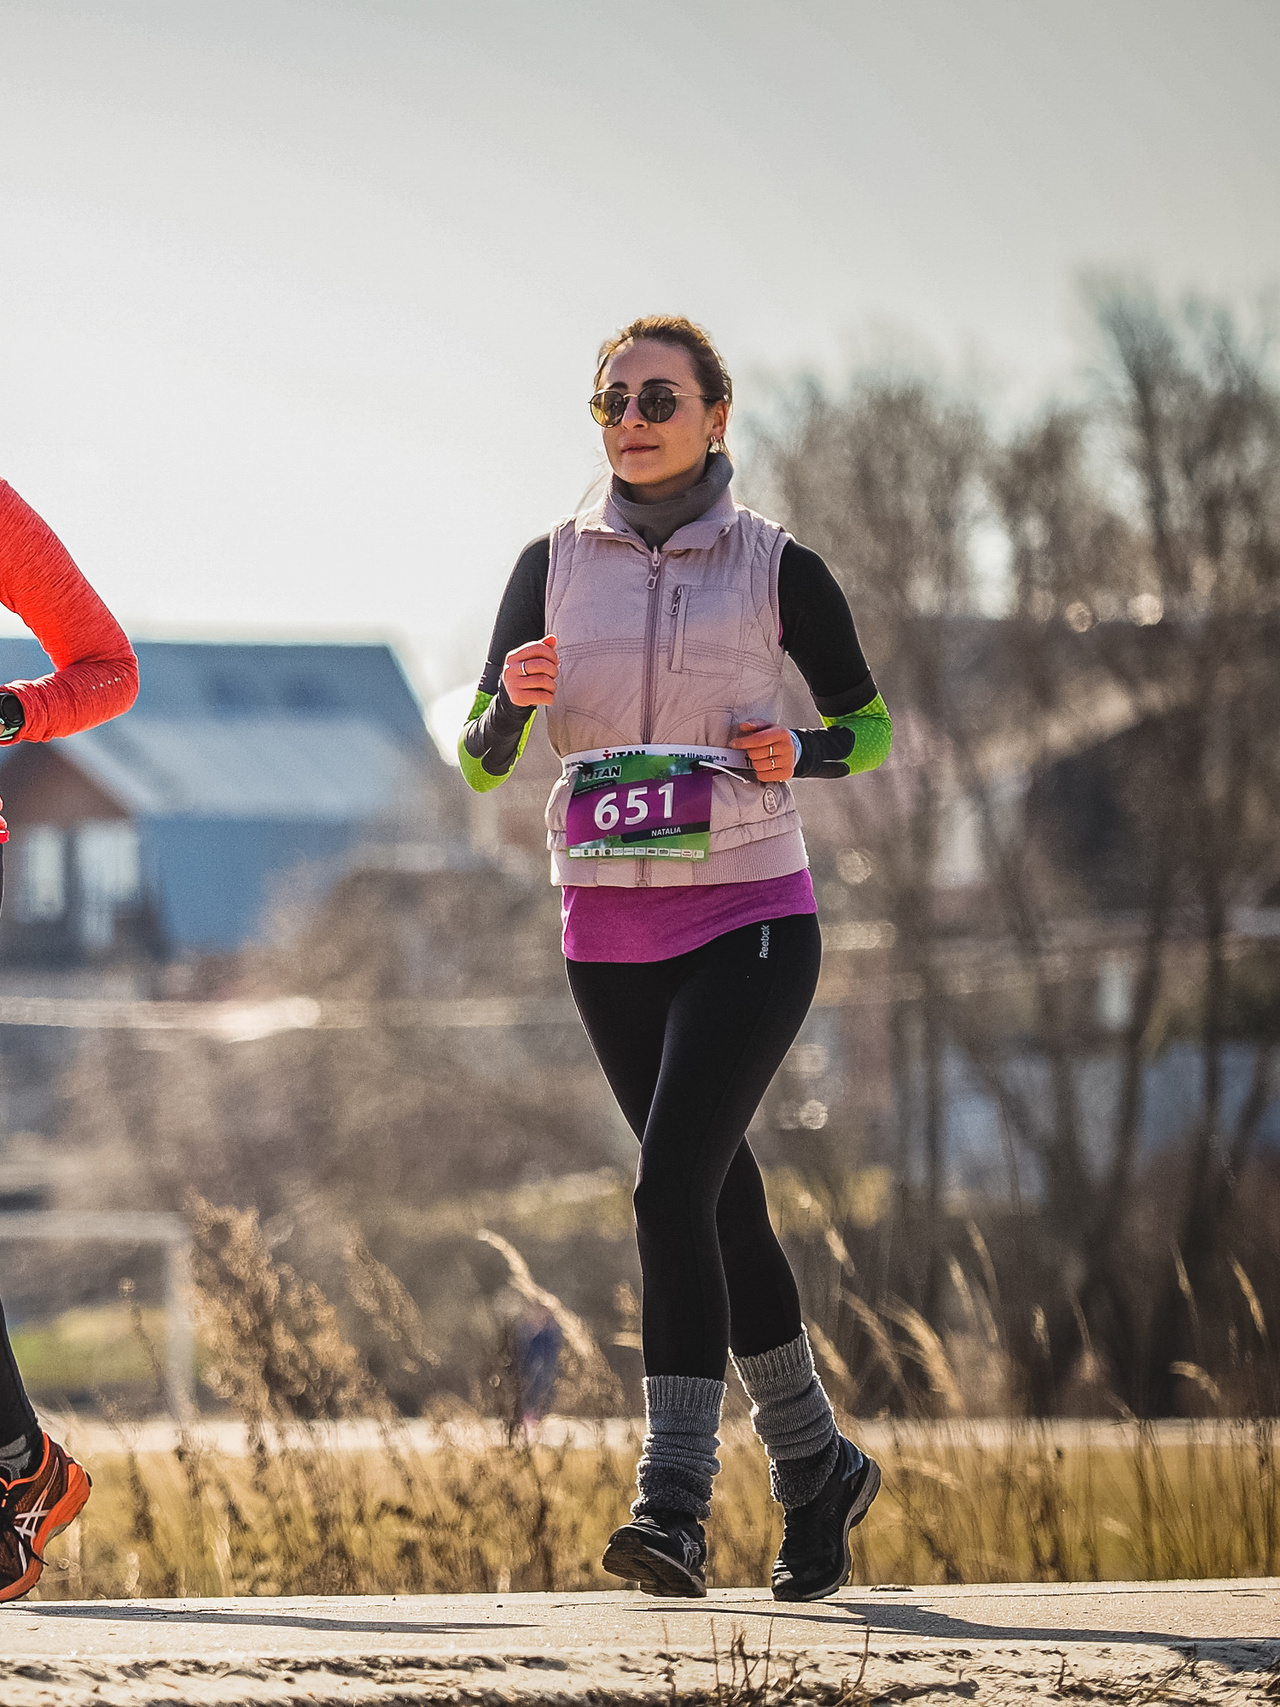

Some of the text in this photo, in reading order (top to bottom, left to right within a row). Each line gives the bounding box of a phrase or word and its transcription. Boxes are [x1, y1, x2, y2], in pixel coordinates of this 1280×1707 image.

[594, 782, 674, 831] 651
[651, 826, 682, 837] NATALIA
[759, 924, 770, 959] Reebok
